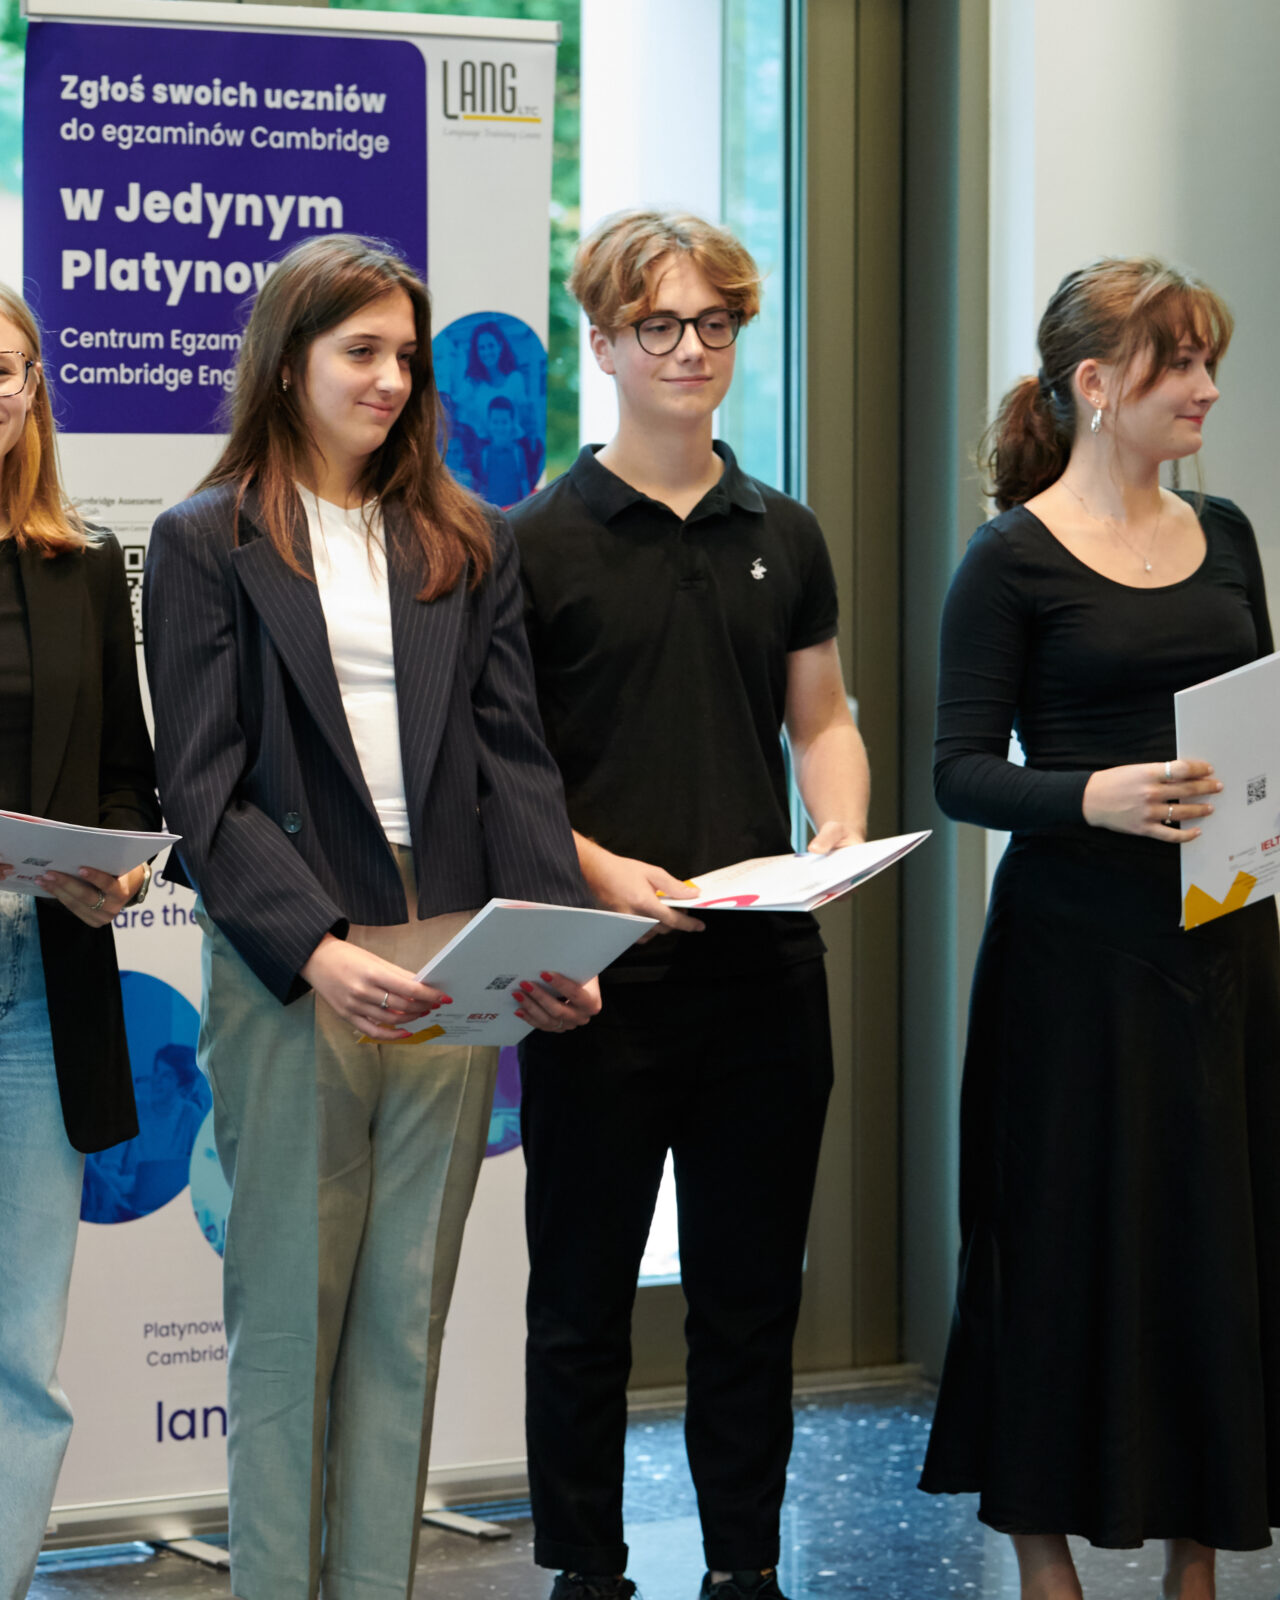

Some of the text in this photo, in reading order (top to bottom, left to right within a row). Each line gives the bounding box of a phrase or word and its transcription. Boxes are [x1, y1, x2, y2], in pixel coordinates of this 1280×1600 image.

[60, 73, 387, 113] Zgłoś swoich uczniów
[442, 60, 517, 120] LANG
[60, 117, 390, 160] do egzaminów Cambridge
[60, 182, 343, 241] w Jedynym
[60, 327, 247, 356] Centrum Egzam
[60, 362, 193, 392] Cambridge
[146, 1345, 228, 1367] Cambrid
